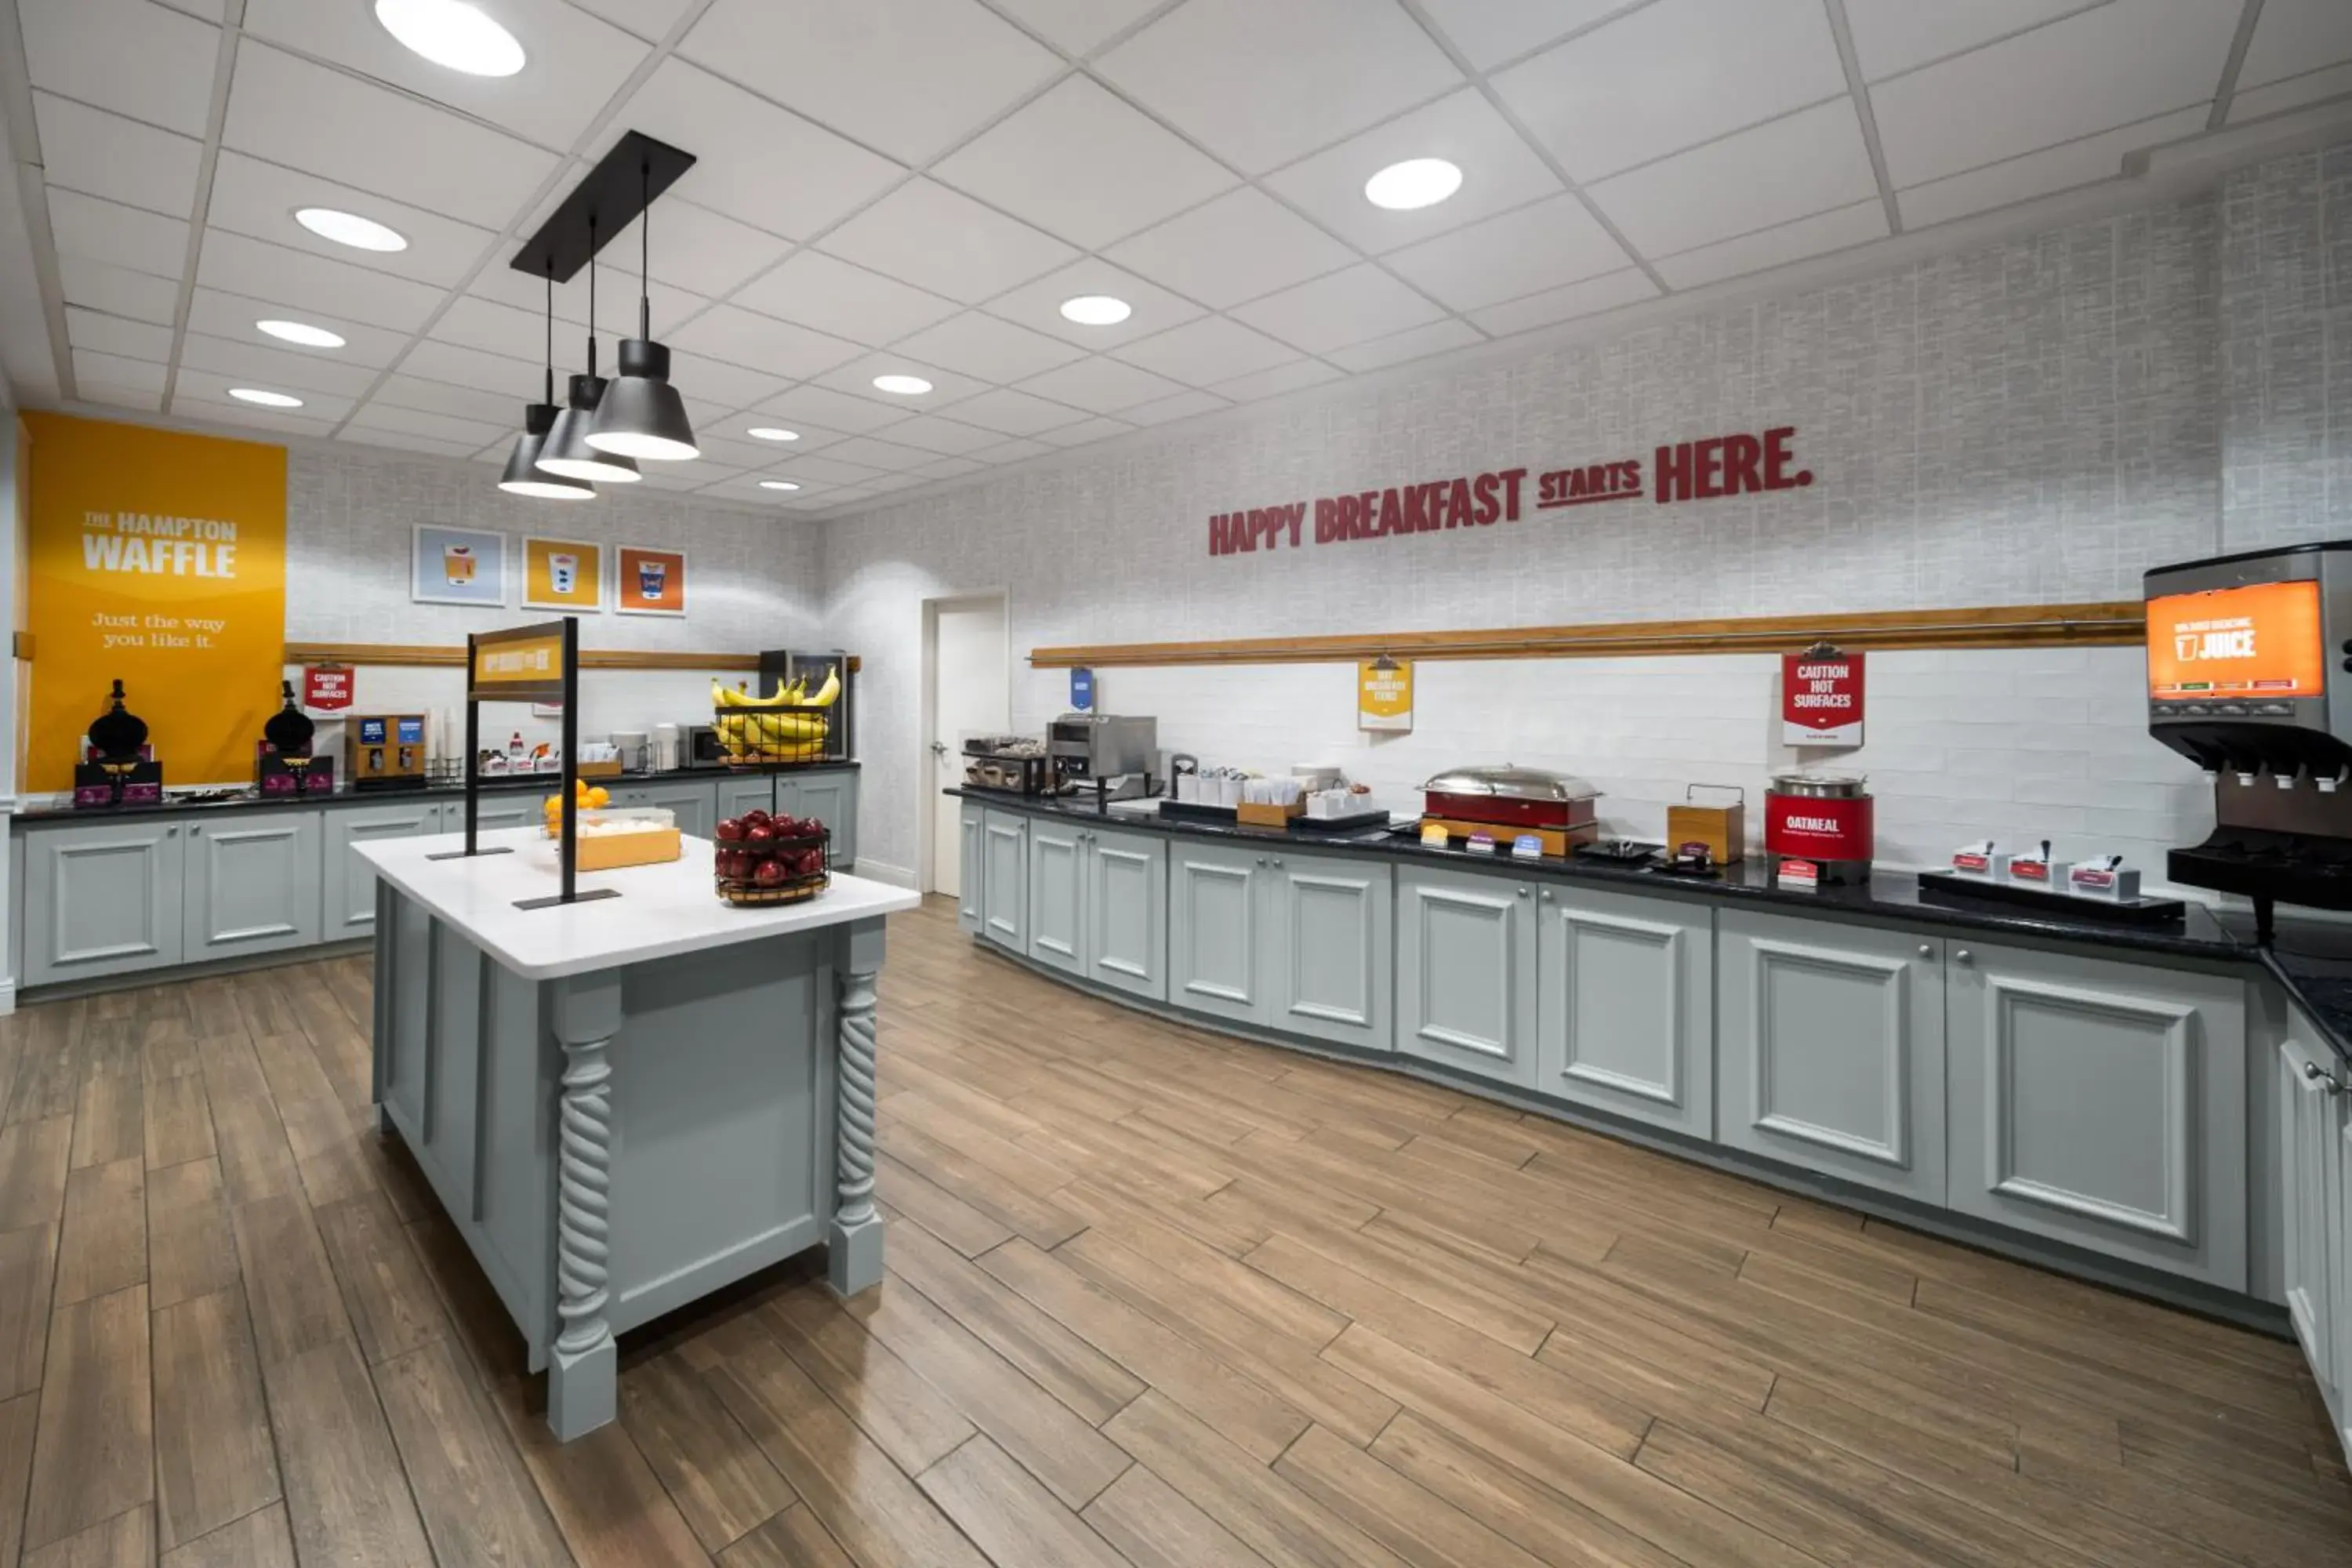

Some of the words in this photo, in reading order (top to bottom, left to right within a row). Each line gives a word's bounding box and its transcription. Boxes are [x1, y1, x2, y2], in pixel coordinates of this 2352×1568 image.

[1209, 502, 1307, 556] HAPPY
[1315, 469, 1527, 544] BREAKFAST
[1539, 459, 1642, 500] STARTS
[1656, 426, 1813, 503] HERE.
[84, 512, 112, 528] THE
[118, 512, 238, 541] HAMPTON
[82, 534, 238, 579] WAFFLE
[92, 612, 137, 627] Just
[145, 615, 179, 629] the
[184, 618, 226, 634] way
[103, 633, 144, 649] you
[151, 633, 190, 648] like
[196, 634, 216, 648] it.
[2199, 629, 2256, 659] JUICE
[1797, 665, 1849, 679] CAUTION
[1810, 680, 1835, 693] HOT
[1794, 694, 1851, 707] SURFACES
[1787, 815, 1840, 833] OATMEAL
